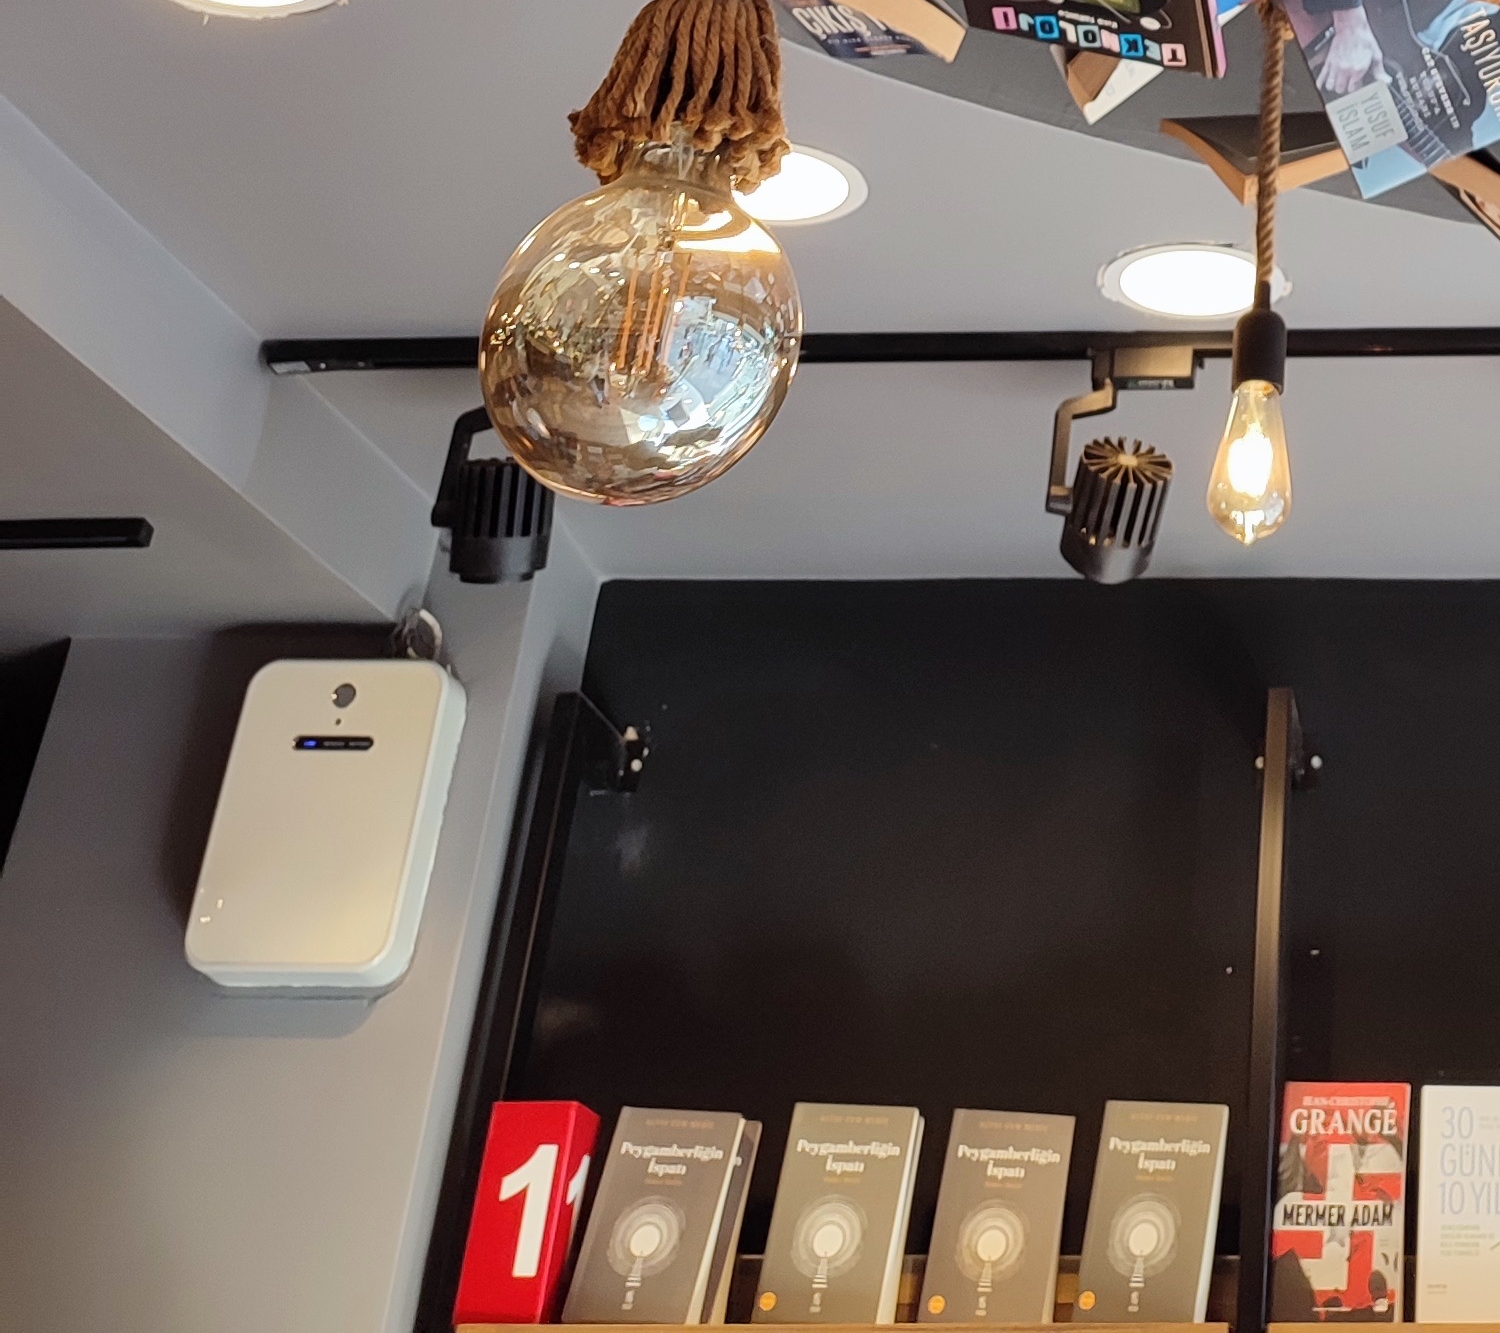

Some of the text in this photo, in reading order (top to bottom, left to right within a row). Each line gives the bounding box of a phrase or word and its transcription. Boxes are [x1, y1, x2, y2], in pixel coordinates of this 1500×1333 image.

[1335, 99, 1379, 152] İSLAM
[1356, 90, 1398, 141] YUSUF
[1289, 1101, 1398, 1135] GRANGÉ
[1440, 1105, 1474, 1140] 30
[498, 1143, 560, 1278] 1
[1282, 1203, 1393, 1227] MERMER ADAM
[1439, 1181, 1466, 1215] 10
